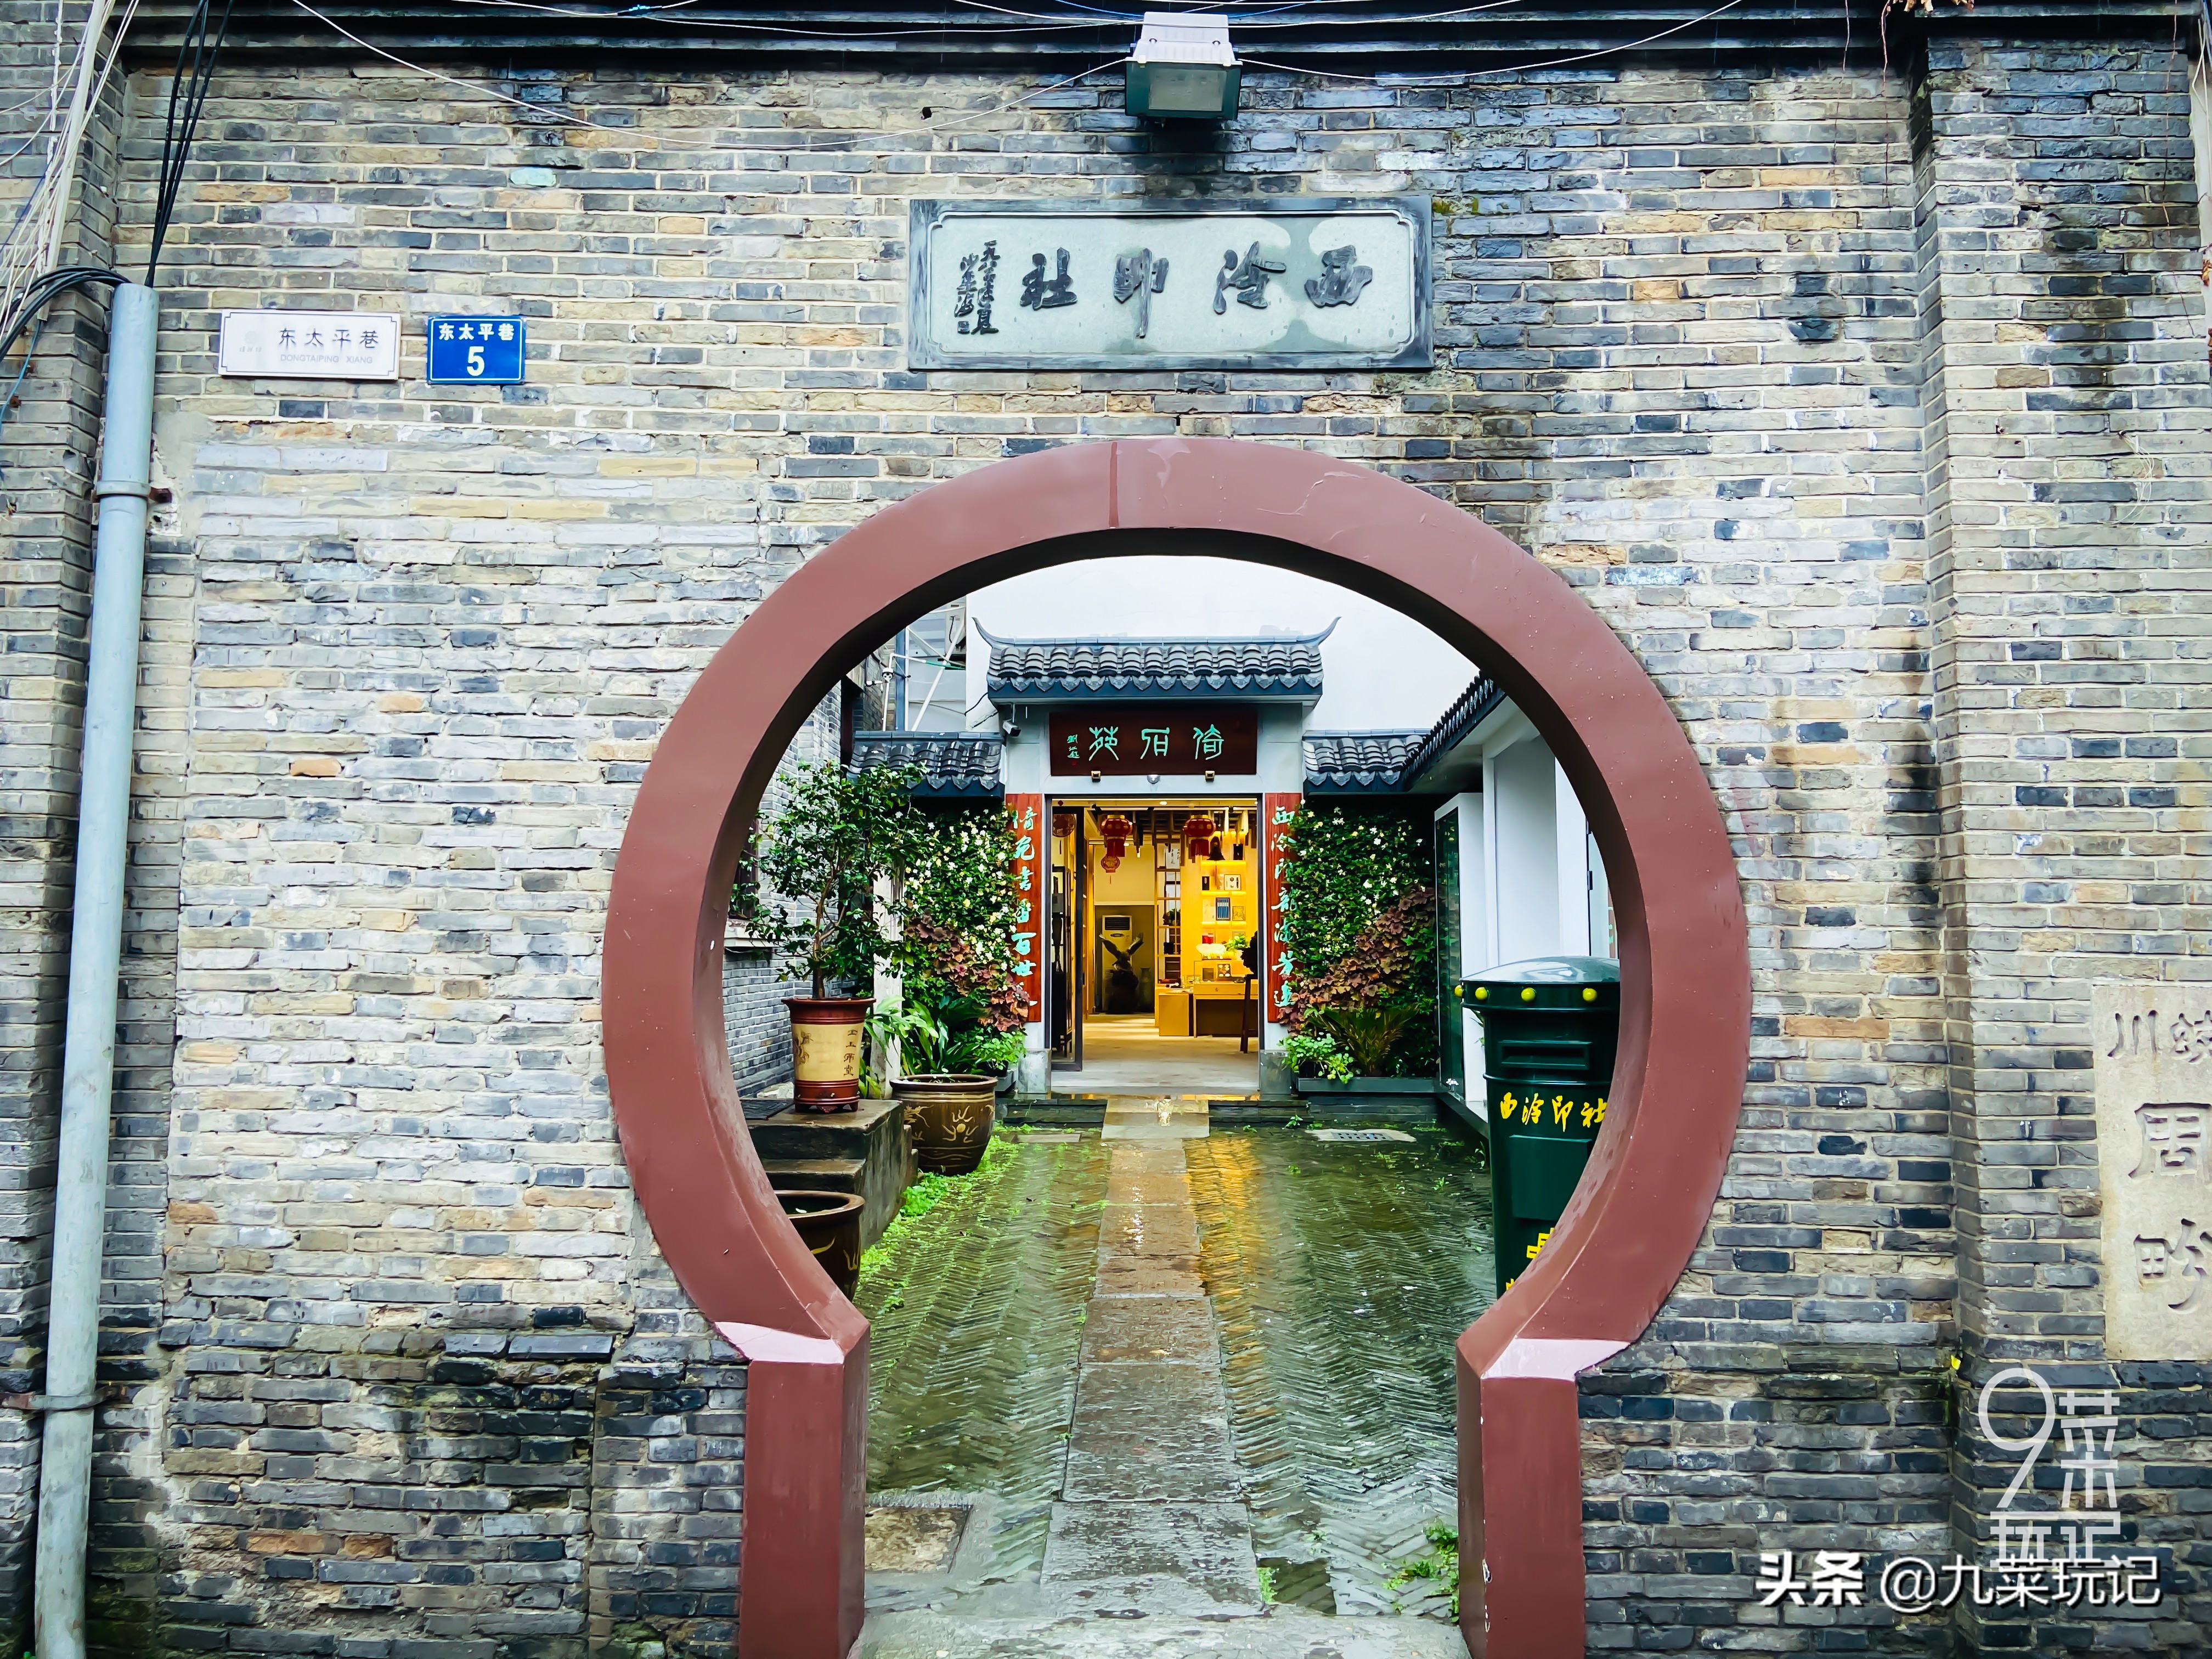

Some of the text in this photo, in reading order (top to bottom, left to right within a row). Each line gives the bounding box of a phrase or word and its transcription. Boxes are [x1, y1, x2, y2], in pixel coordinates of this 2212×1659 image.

[1019, 240, 1374, 339] 西泠印社
[278, 328, 379, 350] 东太平巷
[438, 323, 515, 341] 东太平巷
[280, 354, 373, 364] DONGTAIPING XIANG
[466, 346, 485, 376] 5
[1500, 1092, 1607, 1132] 西泠印社
